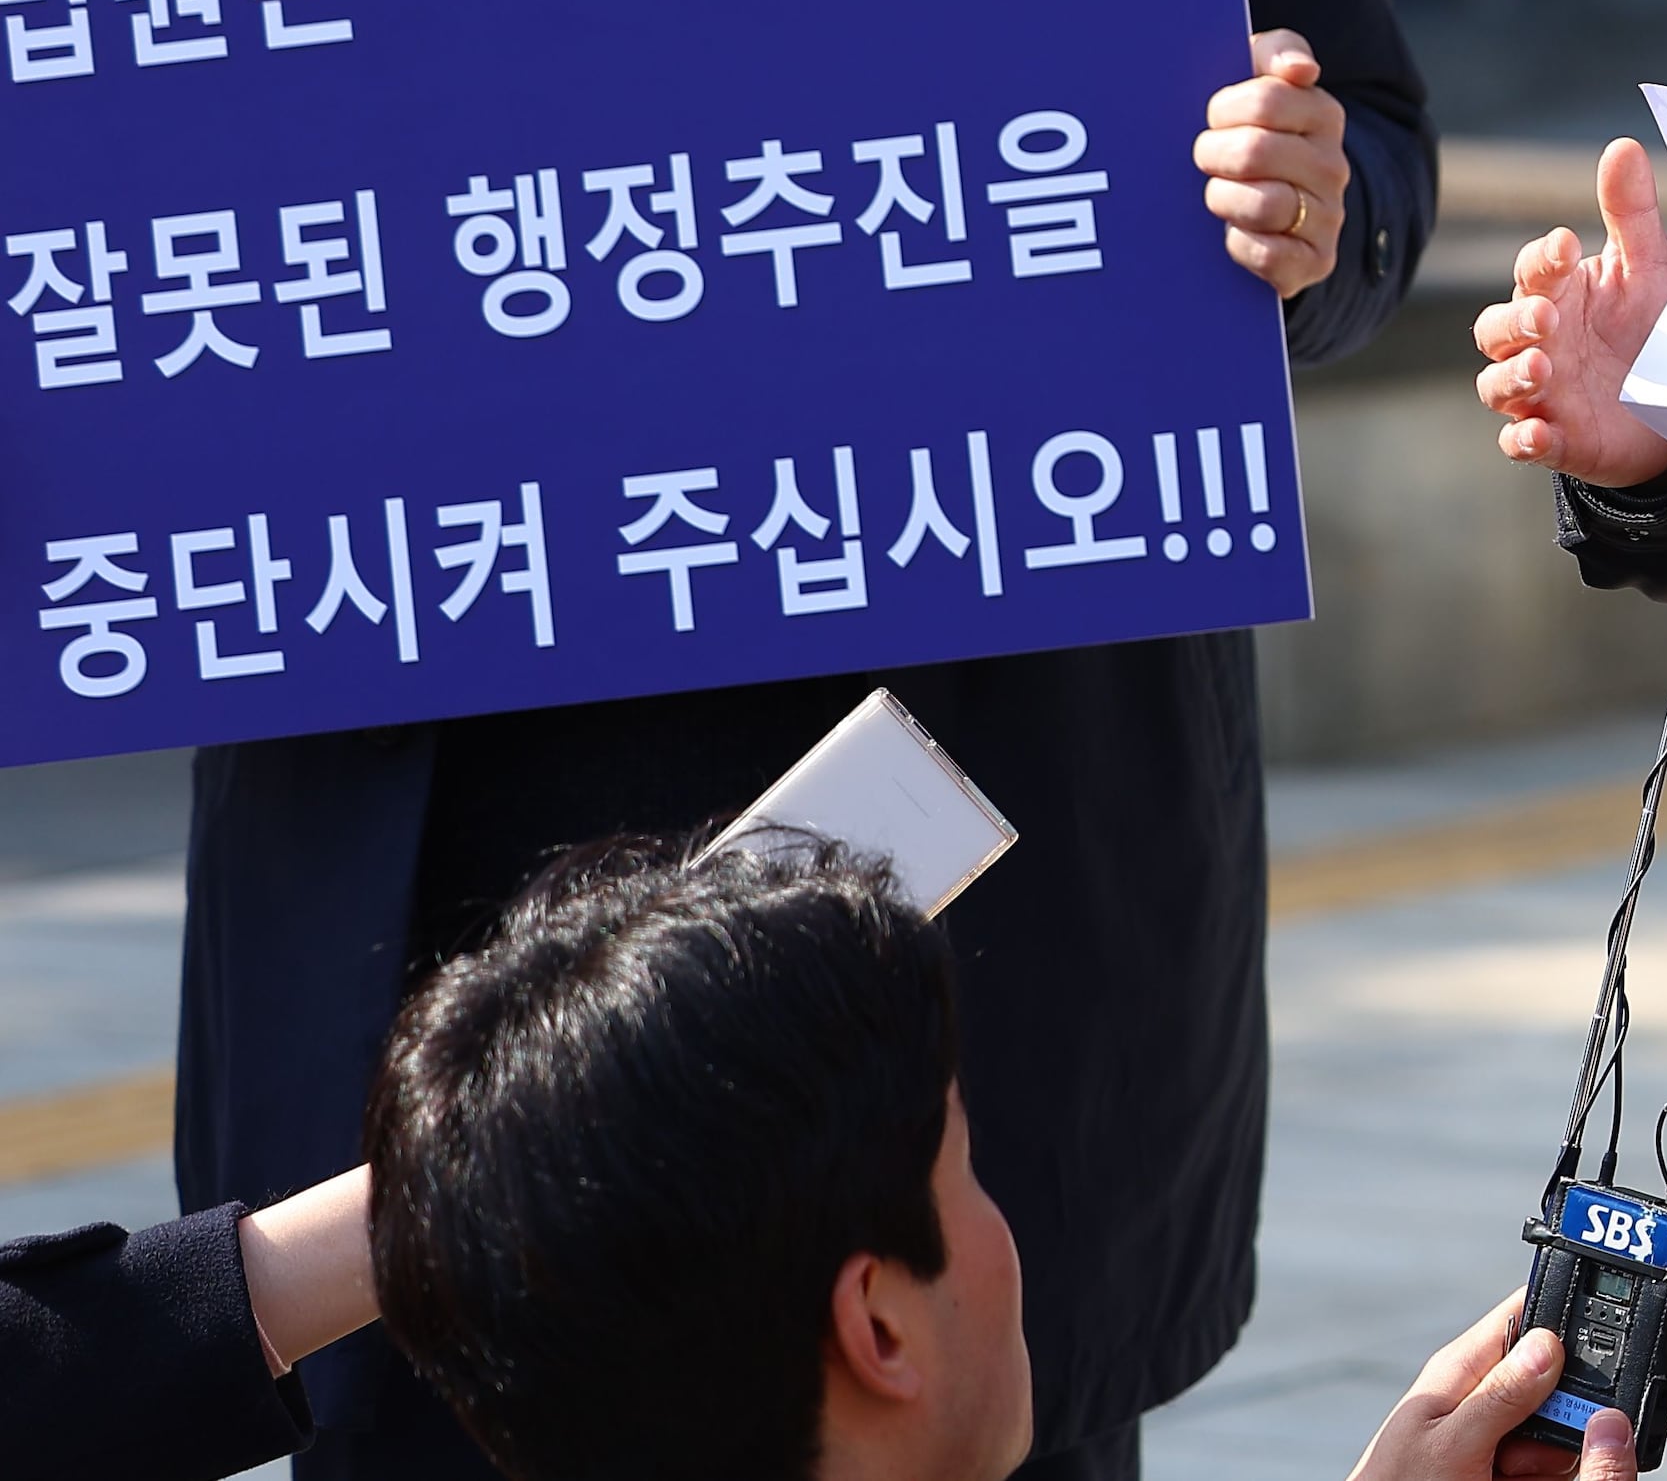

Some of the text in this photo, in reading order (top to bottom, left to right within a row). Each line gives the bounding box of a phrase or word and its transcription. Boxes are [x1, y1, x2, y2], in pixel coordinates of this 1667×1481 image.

[6, 110, 1109, 389] 잘못된 행정추진을
[38, 422, 1277, 698] 중단시켜 주십시오!!!
[1581, 1204, 1656, 1257] SBS
